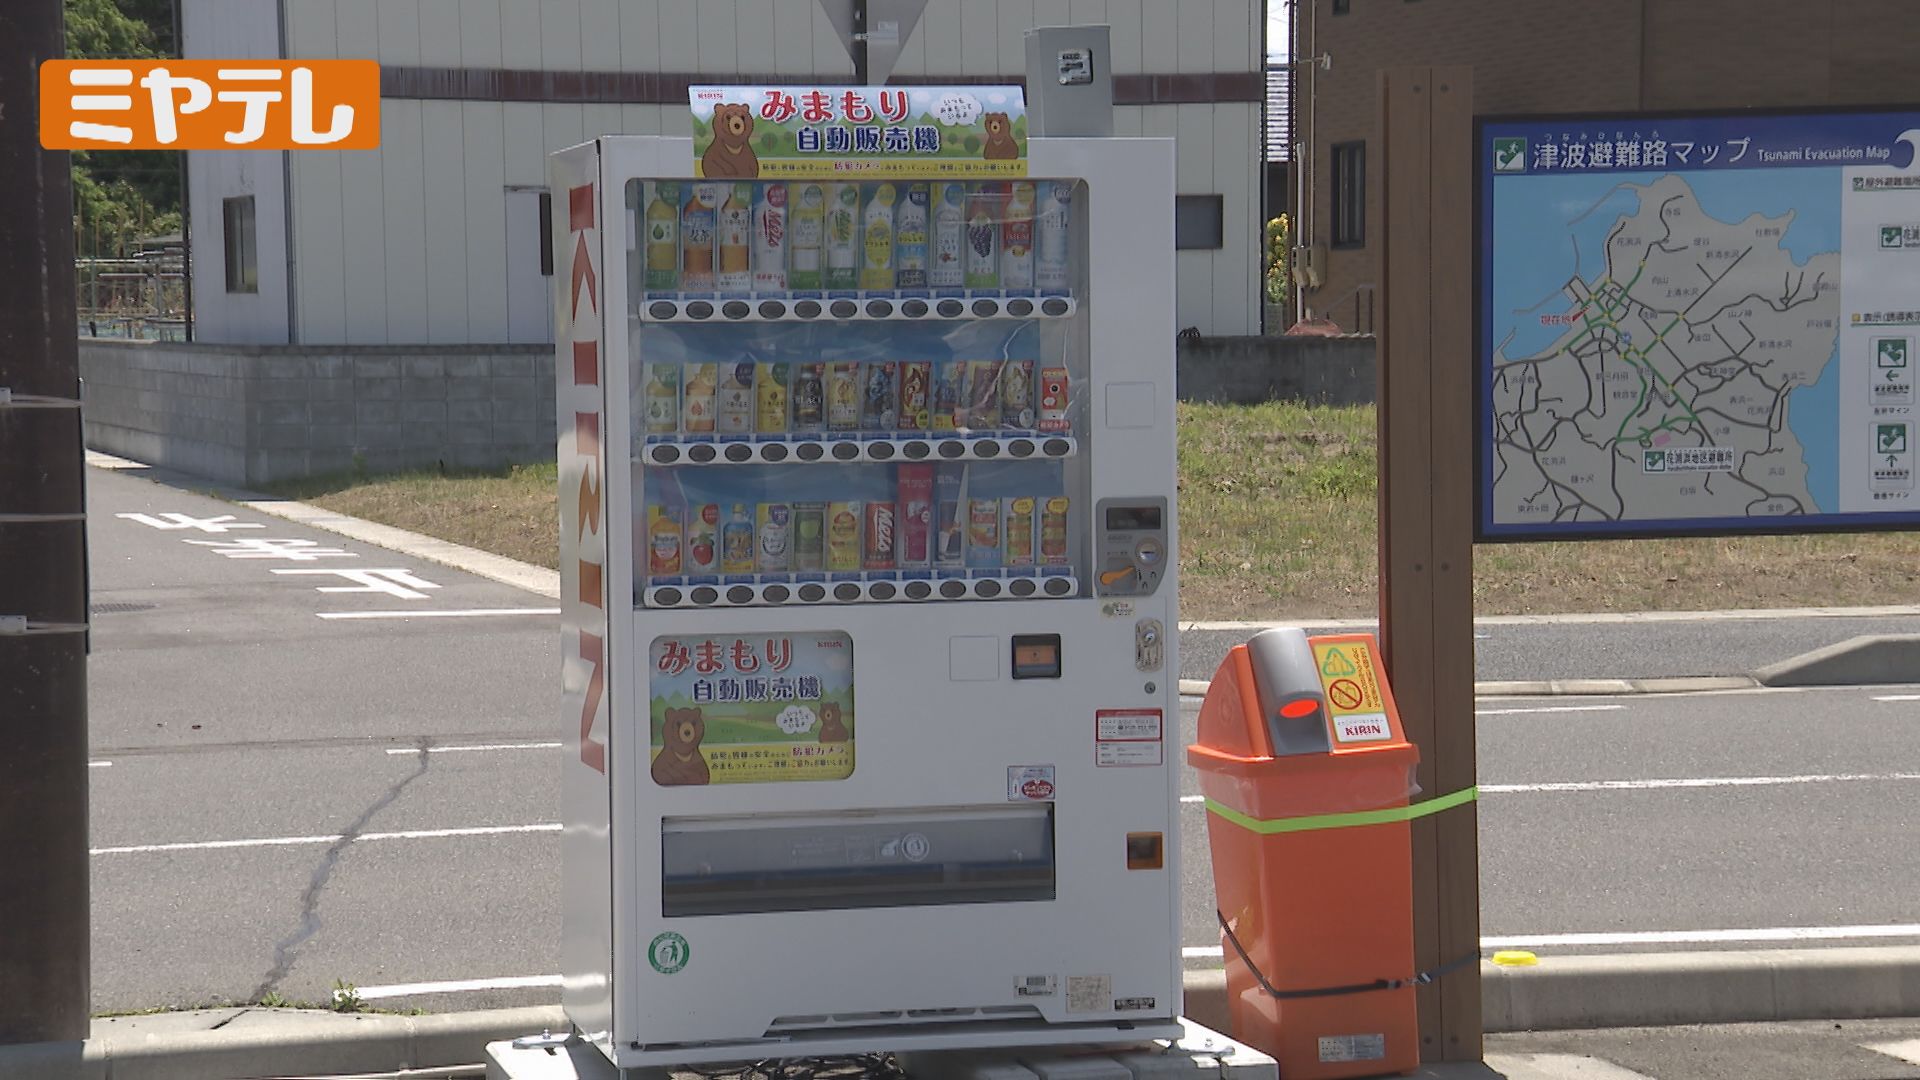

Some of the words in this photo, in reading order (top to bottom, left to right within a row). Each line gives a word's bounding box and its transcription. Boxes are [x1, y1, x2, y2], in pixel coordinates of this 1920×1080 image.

[761, 89, 909, 124] みまもり
[797, 126, 938, 154] 自動販売機
[1533, 136, 1752, 169] 津波避難路マップ
[1758, 149, 1803, 162] Tsunami
[1805, 147, 1863, 161] Evacuation
[1866, 146, 1891, 160] Map
[569, 183, 605, 776] KIRIN
[657, 638, 792, 674] みまもり
[692, 675, 821, 704] 自動販売機
[1345, 726, 1380, 736] KIRIN
